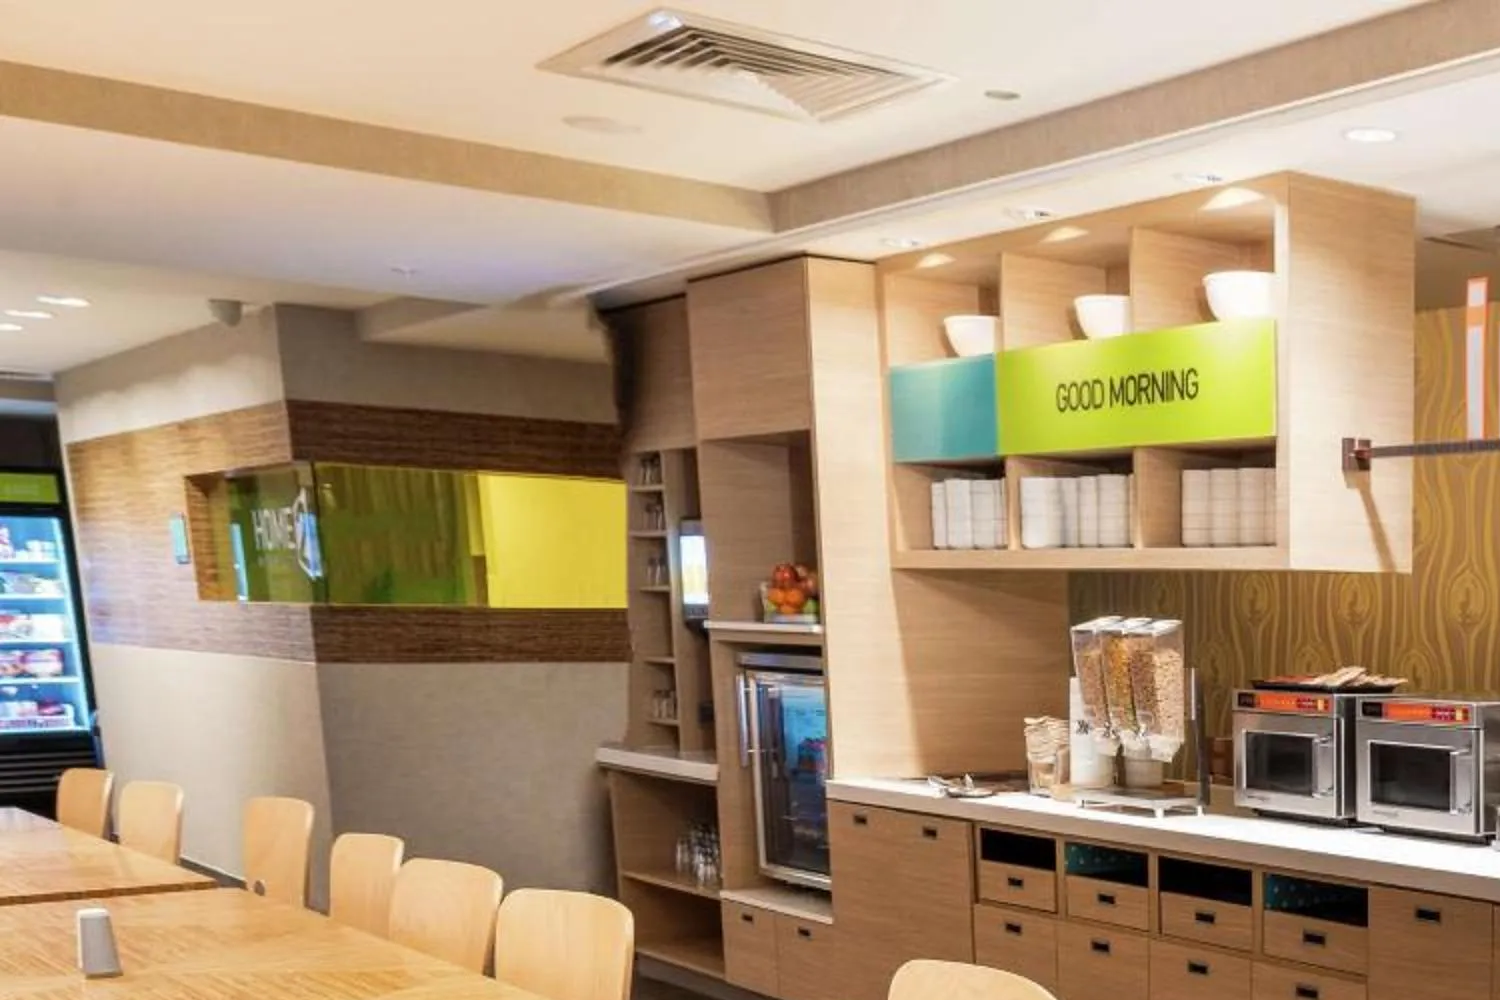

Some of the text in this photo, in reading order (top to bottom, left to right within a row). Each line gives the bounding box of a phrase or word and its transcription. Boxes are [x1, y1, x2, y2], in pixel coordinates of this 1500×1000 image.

[1056, 367, 1199, 413] GOOD MORNING
[251, 507, 296, 551] HOME
